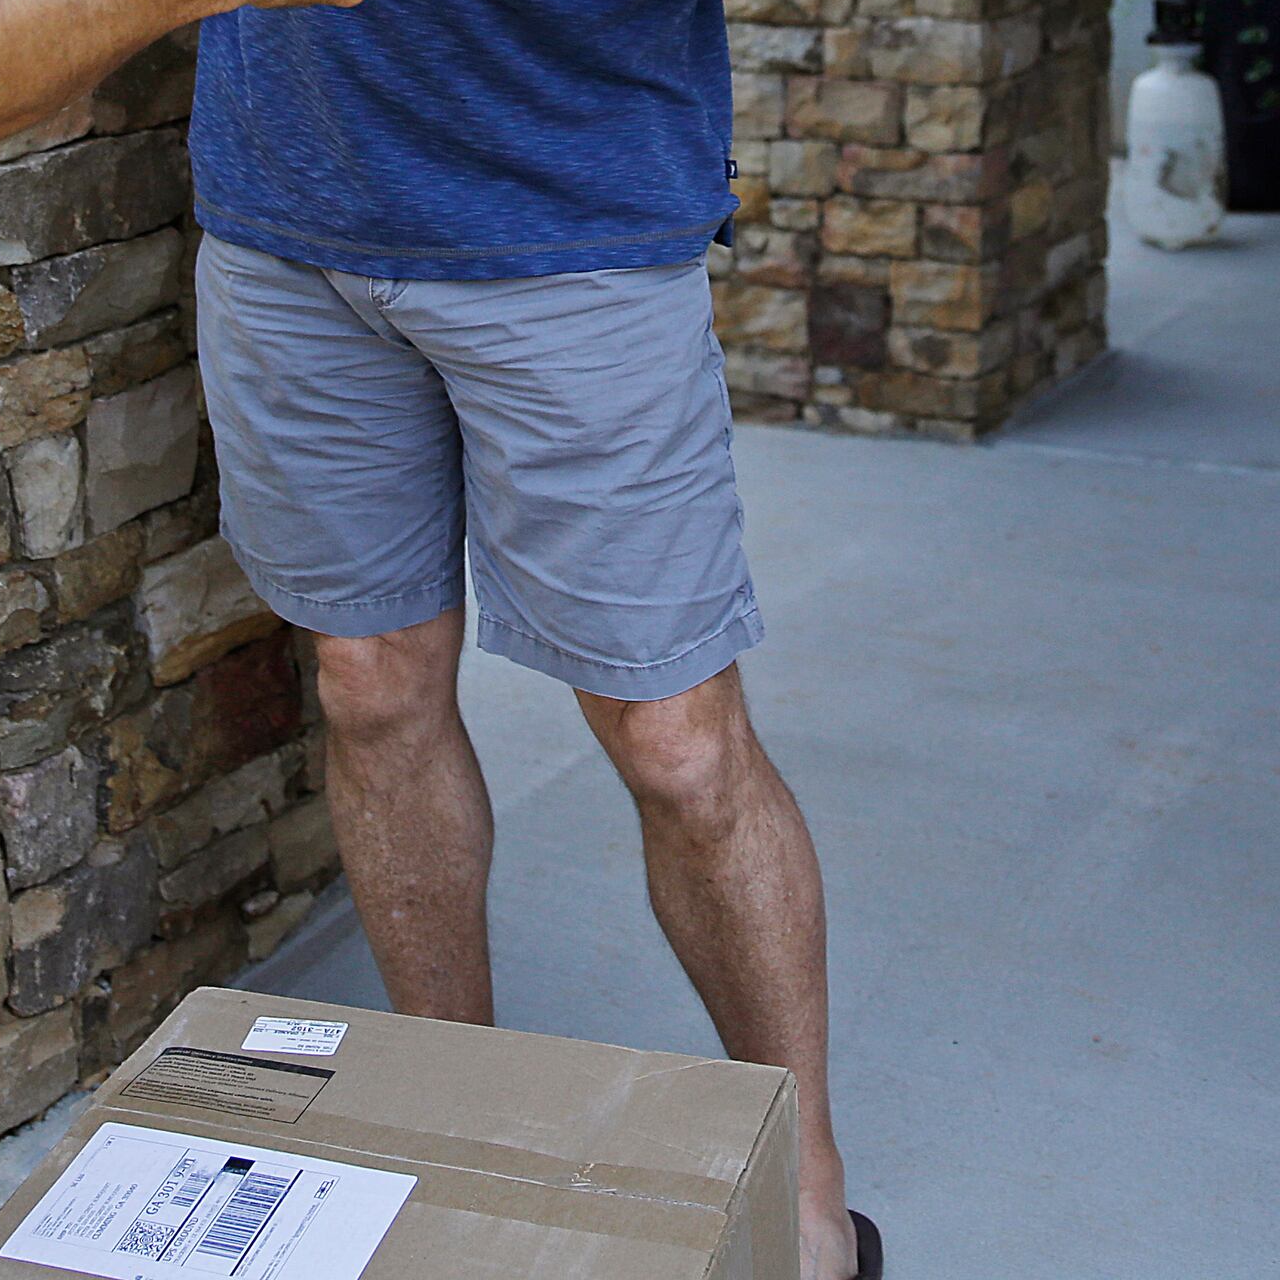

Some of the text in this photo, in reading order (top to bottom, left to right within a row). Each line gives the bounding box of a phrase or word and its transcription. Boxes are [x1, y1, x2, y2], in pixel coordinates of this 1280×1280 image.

[145, 1200, 164, 1216] GA
[157, 1180, 179, 1199] 301
[162, 1216, 199, 1262] UPS GROUND
